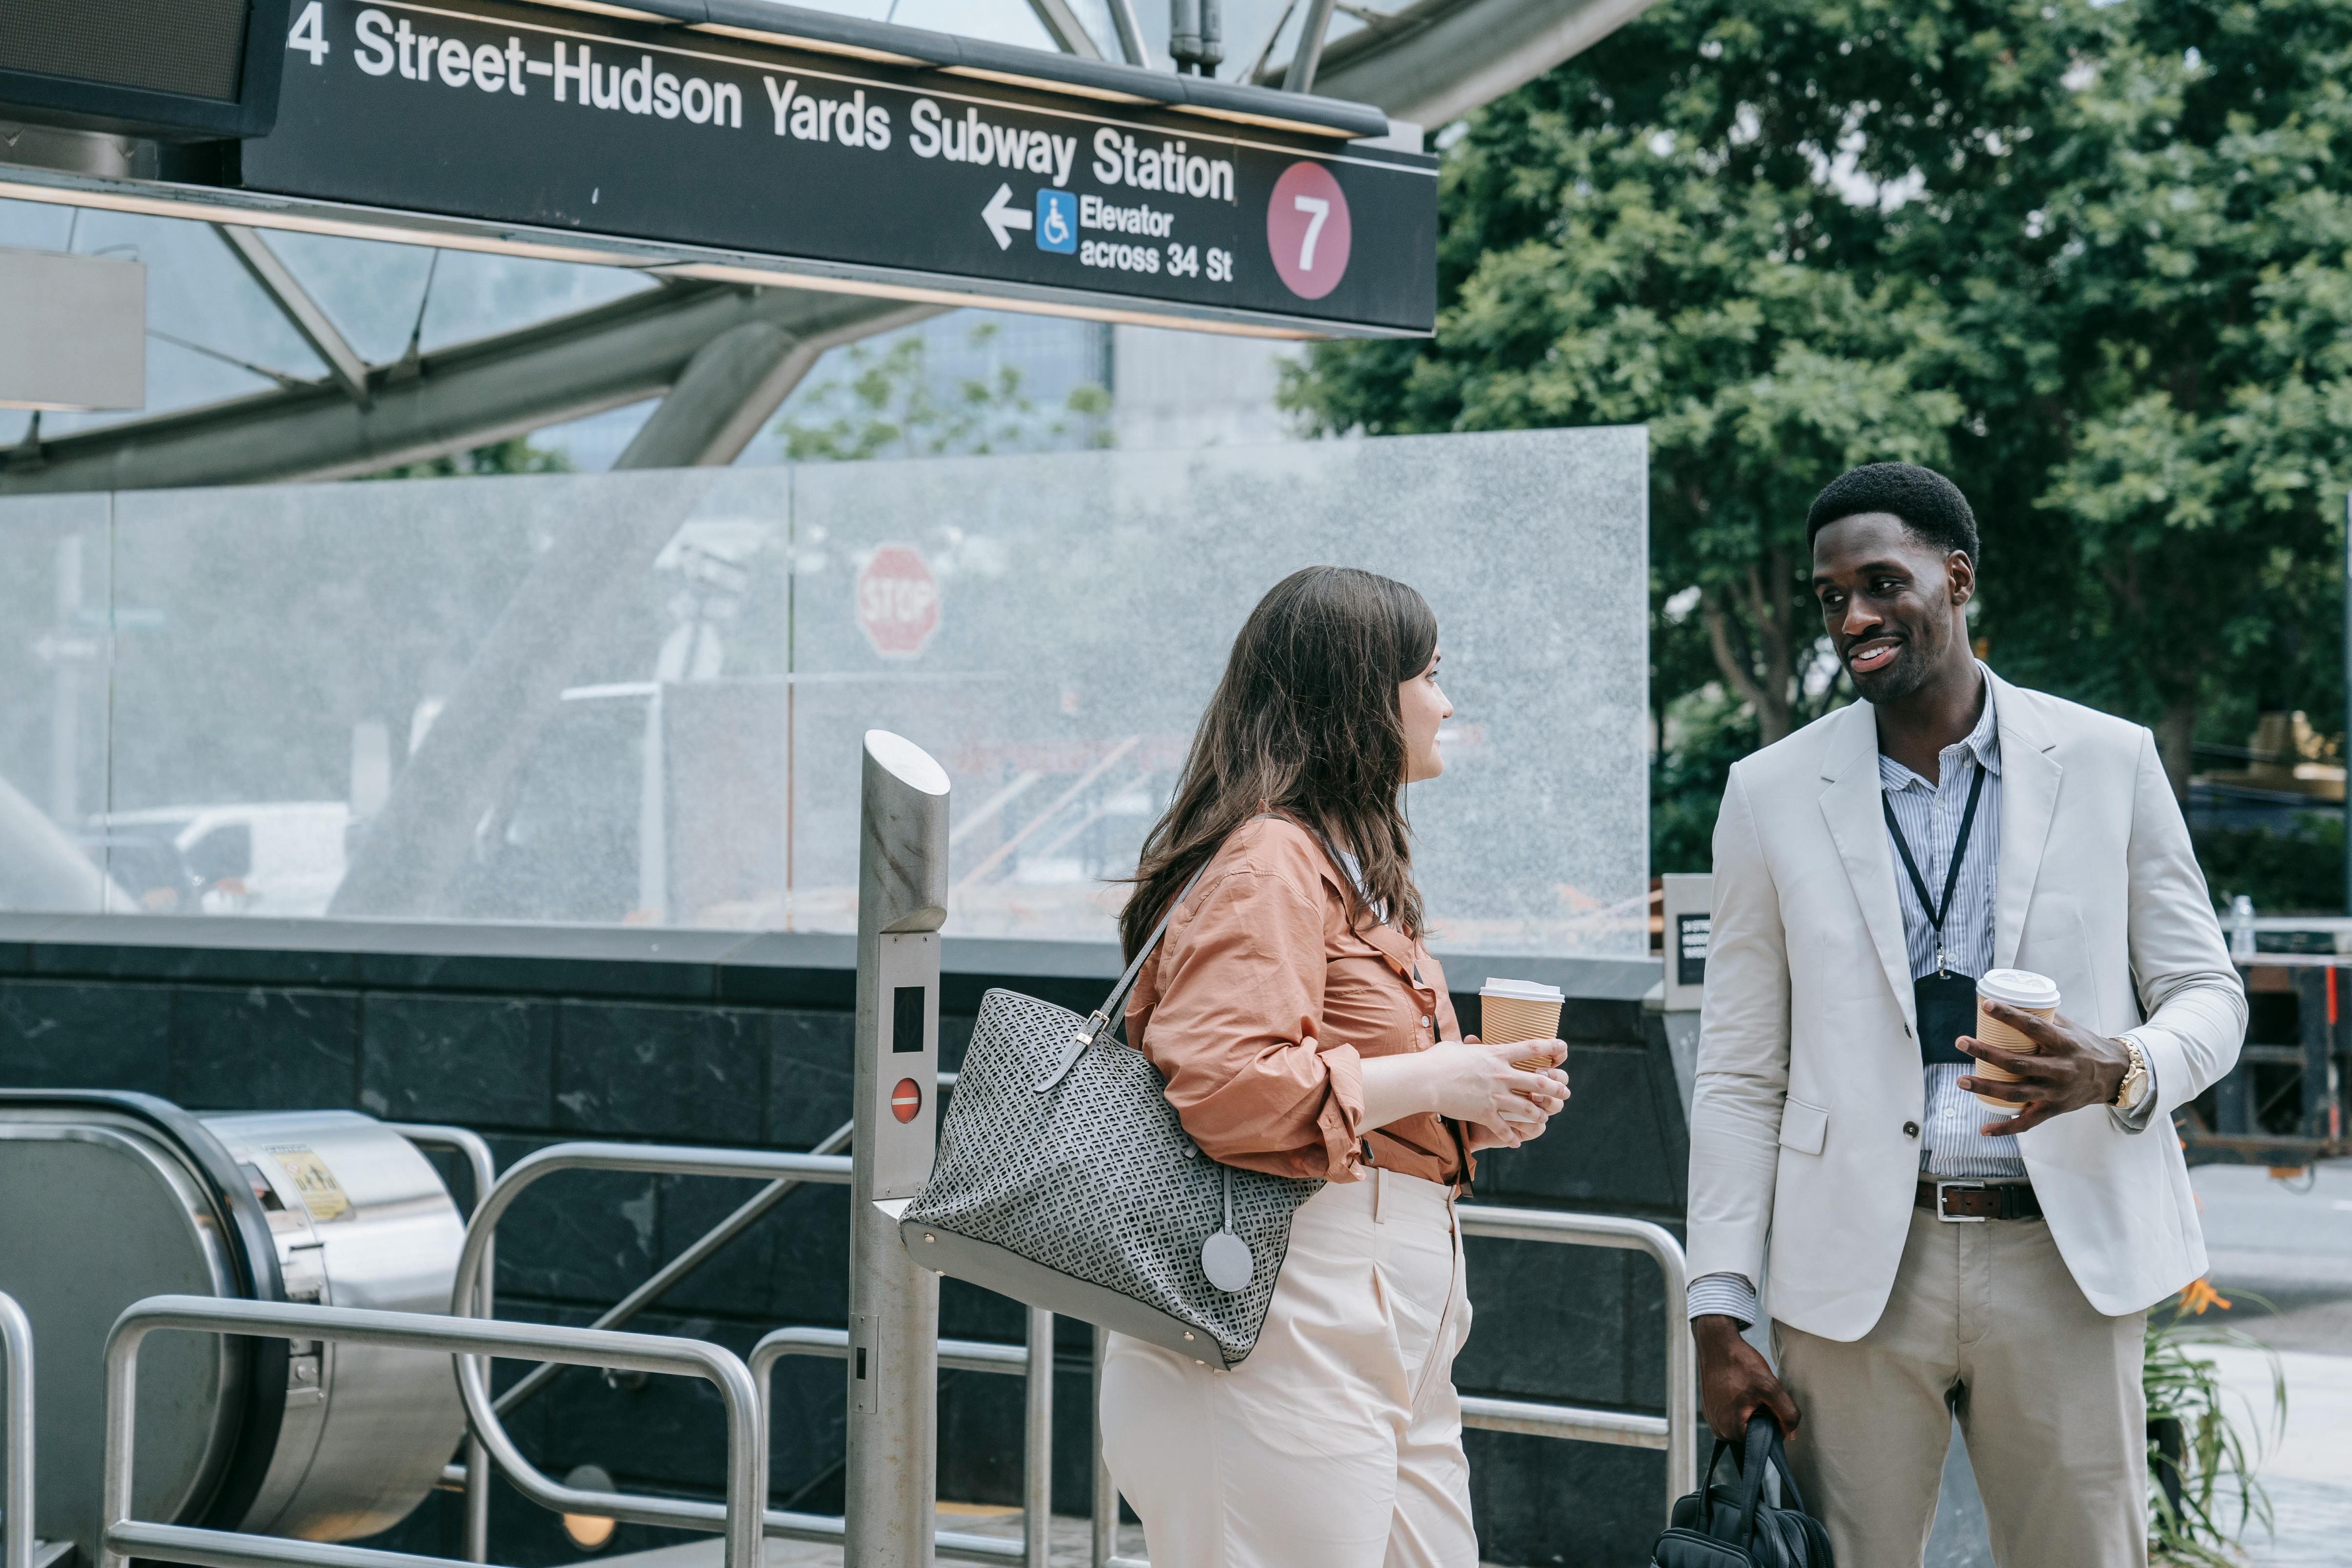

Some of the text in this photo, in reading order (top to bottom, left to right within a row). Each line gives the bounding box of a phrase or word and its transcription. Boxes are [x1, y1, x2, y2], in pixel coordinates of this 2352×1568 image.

[285, 0, 1234, 201] 4 Street-Hudson Yards Subway Station
[1080, 194, 1175, 238] Elevator
[1295, 196, 1329, 271] 7
[1080, 240, 1233, 282] across 34 St
[862, 577, 932, 622] STOP
